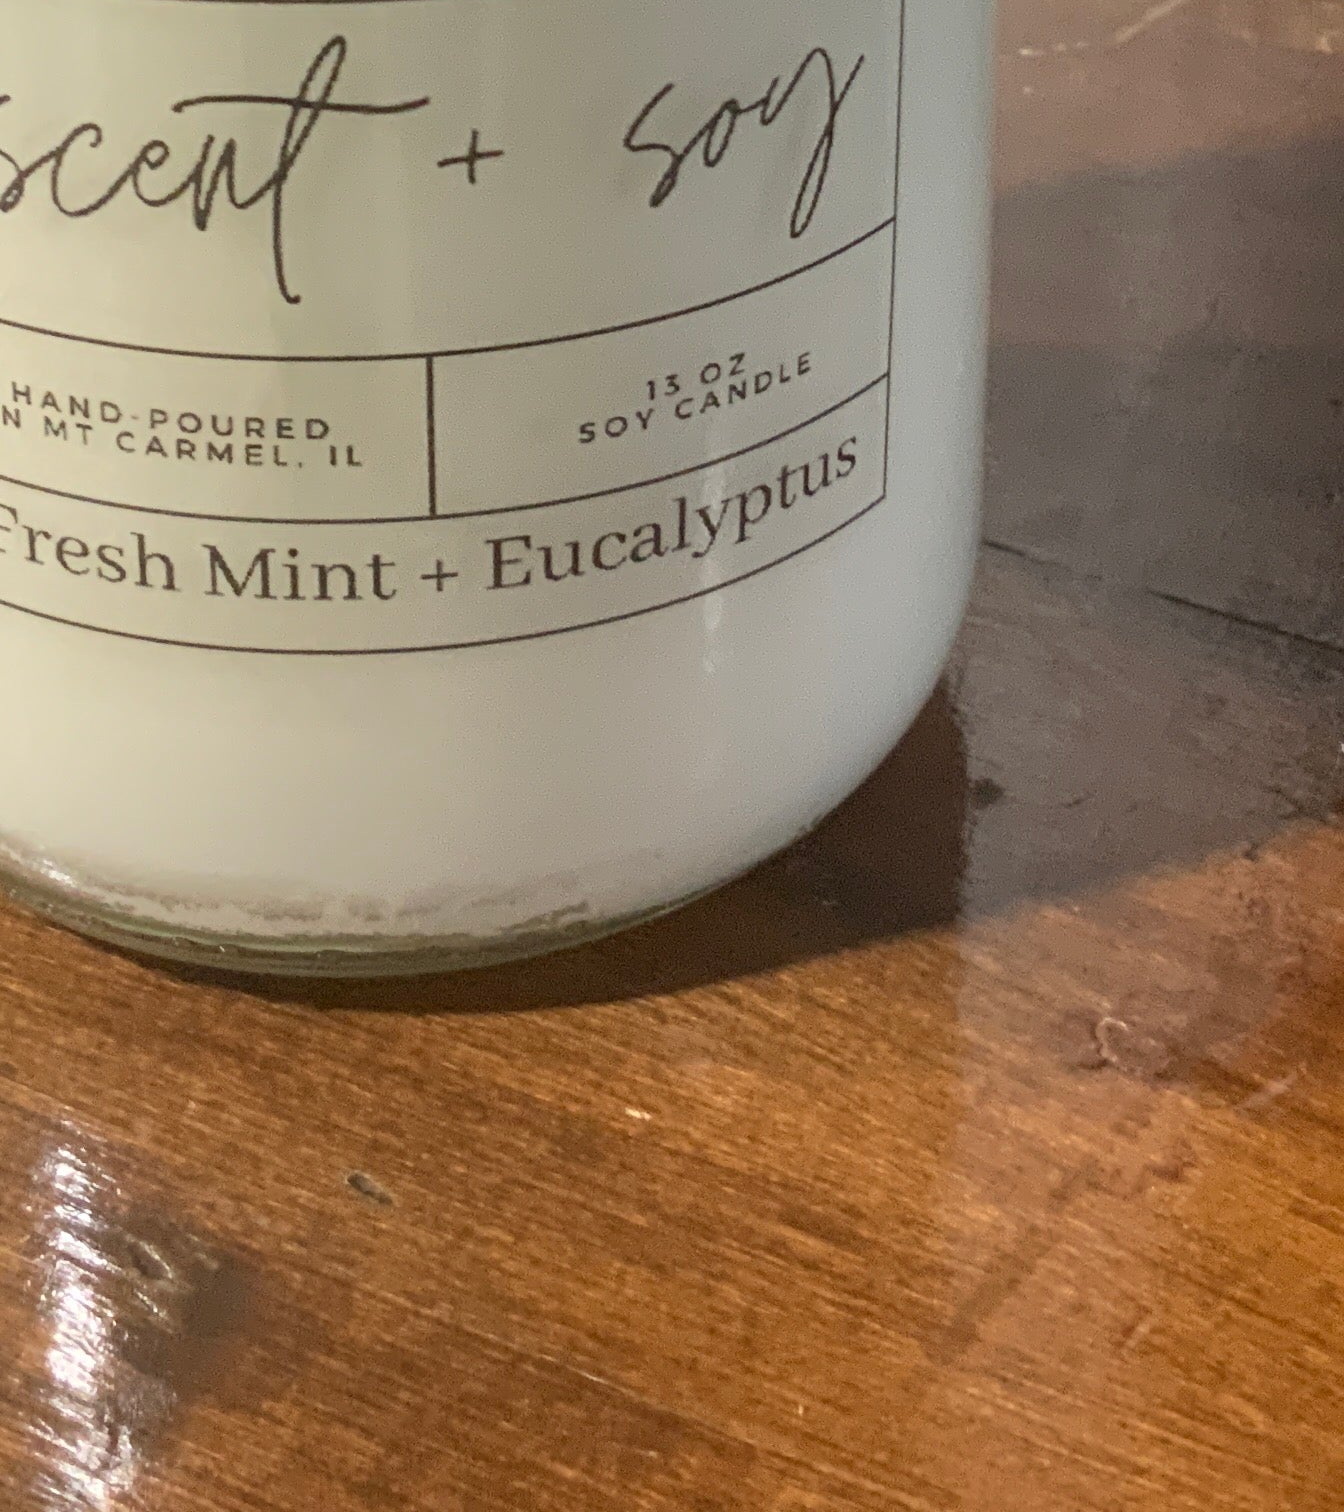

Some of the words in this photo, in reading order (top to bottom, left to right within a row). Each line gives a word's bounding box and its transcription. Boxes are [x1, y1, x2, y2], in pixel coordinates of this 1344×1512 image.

[436, 129, 505, 183] +
[623, 47, 865, 239] soy
[11, 380, 331, 442] HAND-POURED
[577, 407, 656, 445] SOY
[674, 352, 813, 421] CANDLE
[646, 373, 682, 401] 13
[699, 352, 748, 386] OZ
[43, 417, 94, 446] MT
[328, 444, 363, 468] IL
[202, 543, 397, 601] Mint
[420, 559, 459, 592] +
[484, 435, 858, 591] Eucalyptus
